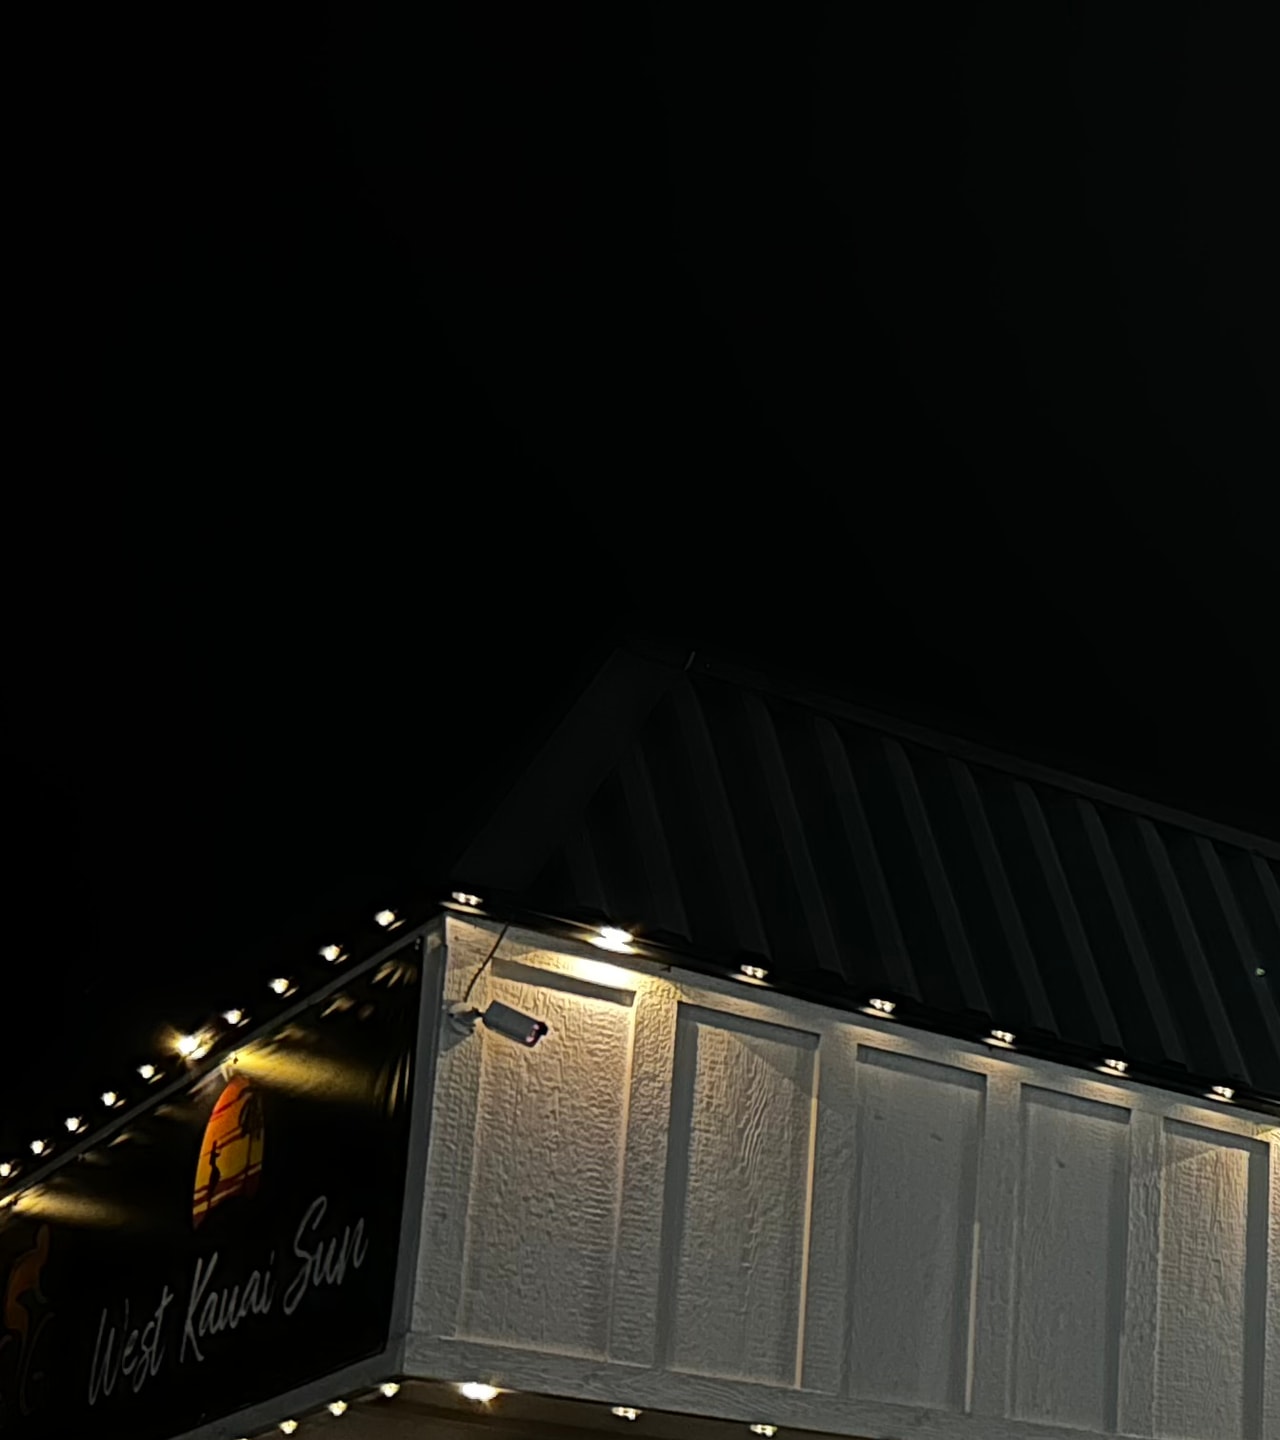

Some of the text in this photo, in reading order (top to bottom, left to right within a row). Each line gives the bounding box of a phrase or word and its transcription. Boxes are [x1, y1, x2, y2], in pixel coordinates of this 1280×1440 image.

[87, 1285, 174, 1407] West
[178, 1249, 276, 1364] Kauai
[282, 1195, 368, 1318] Sun
